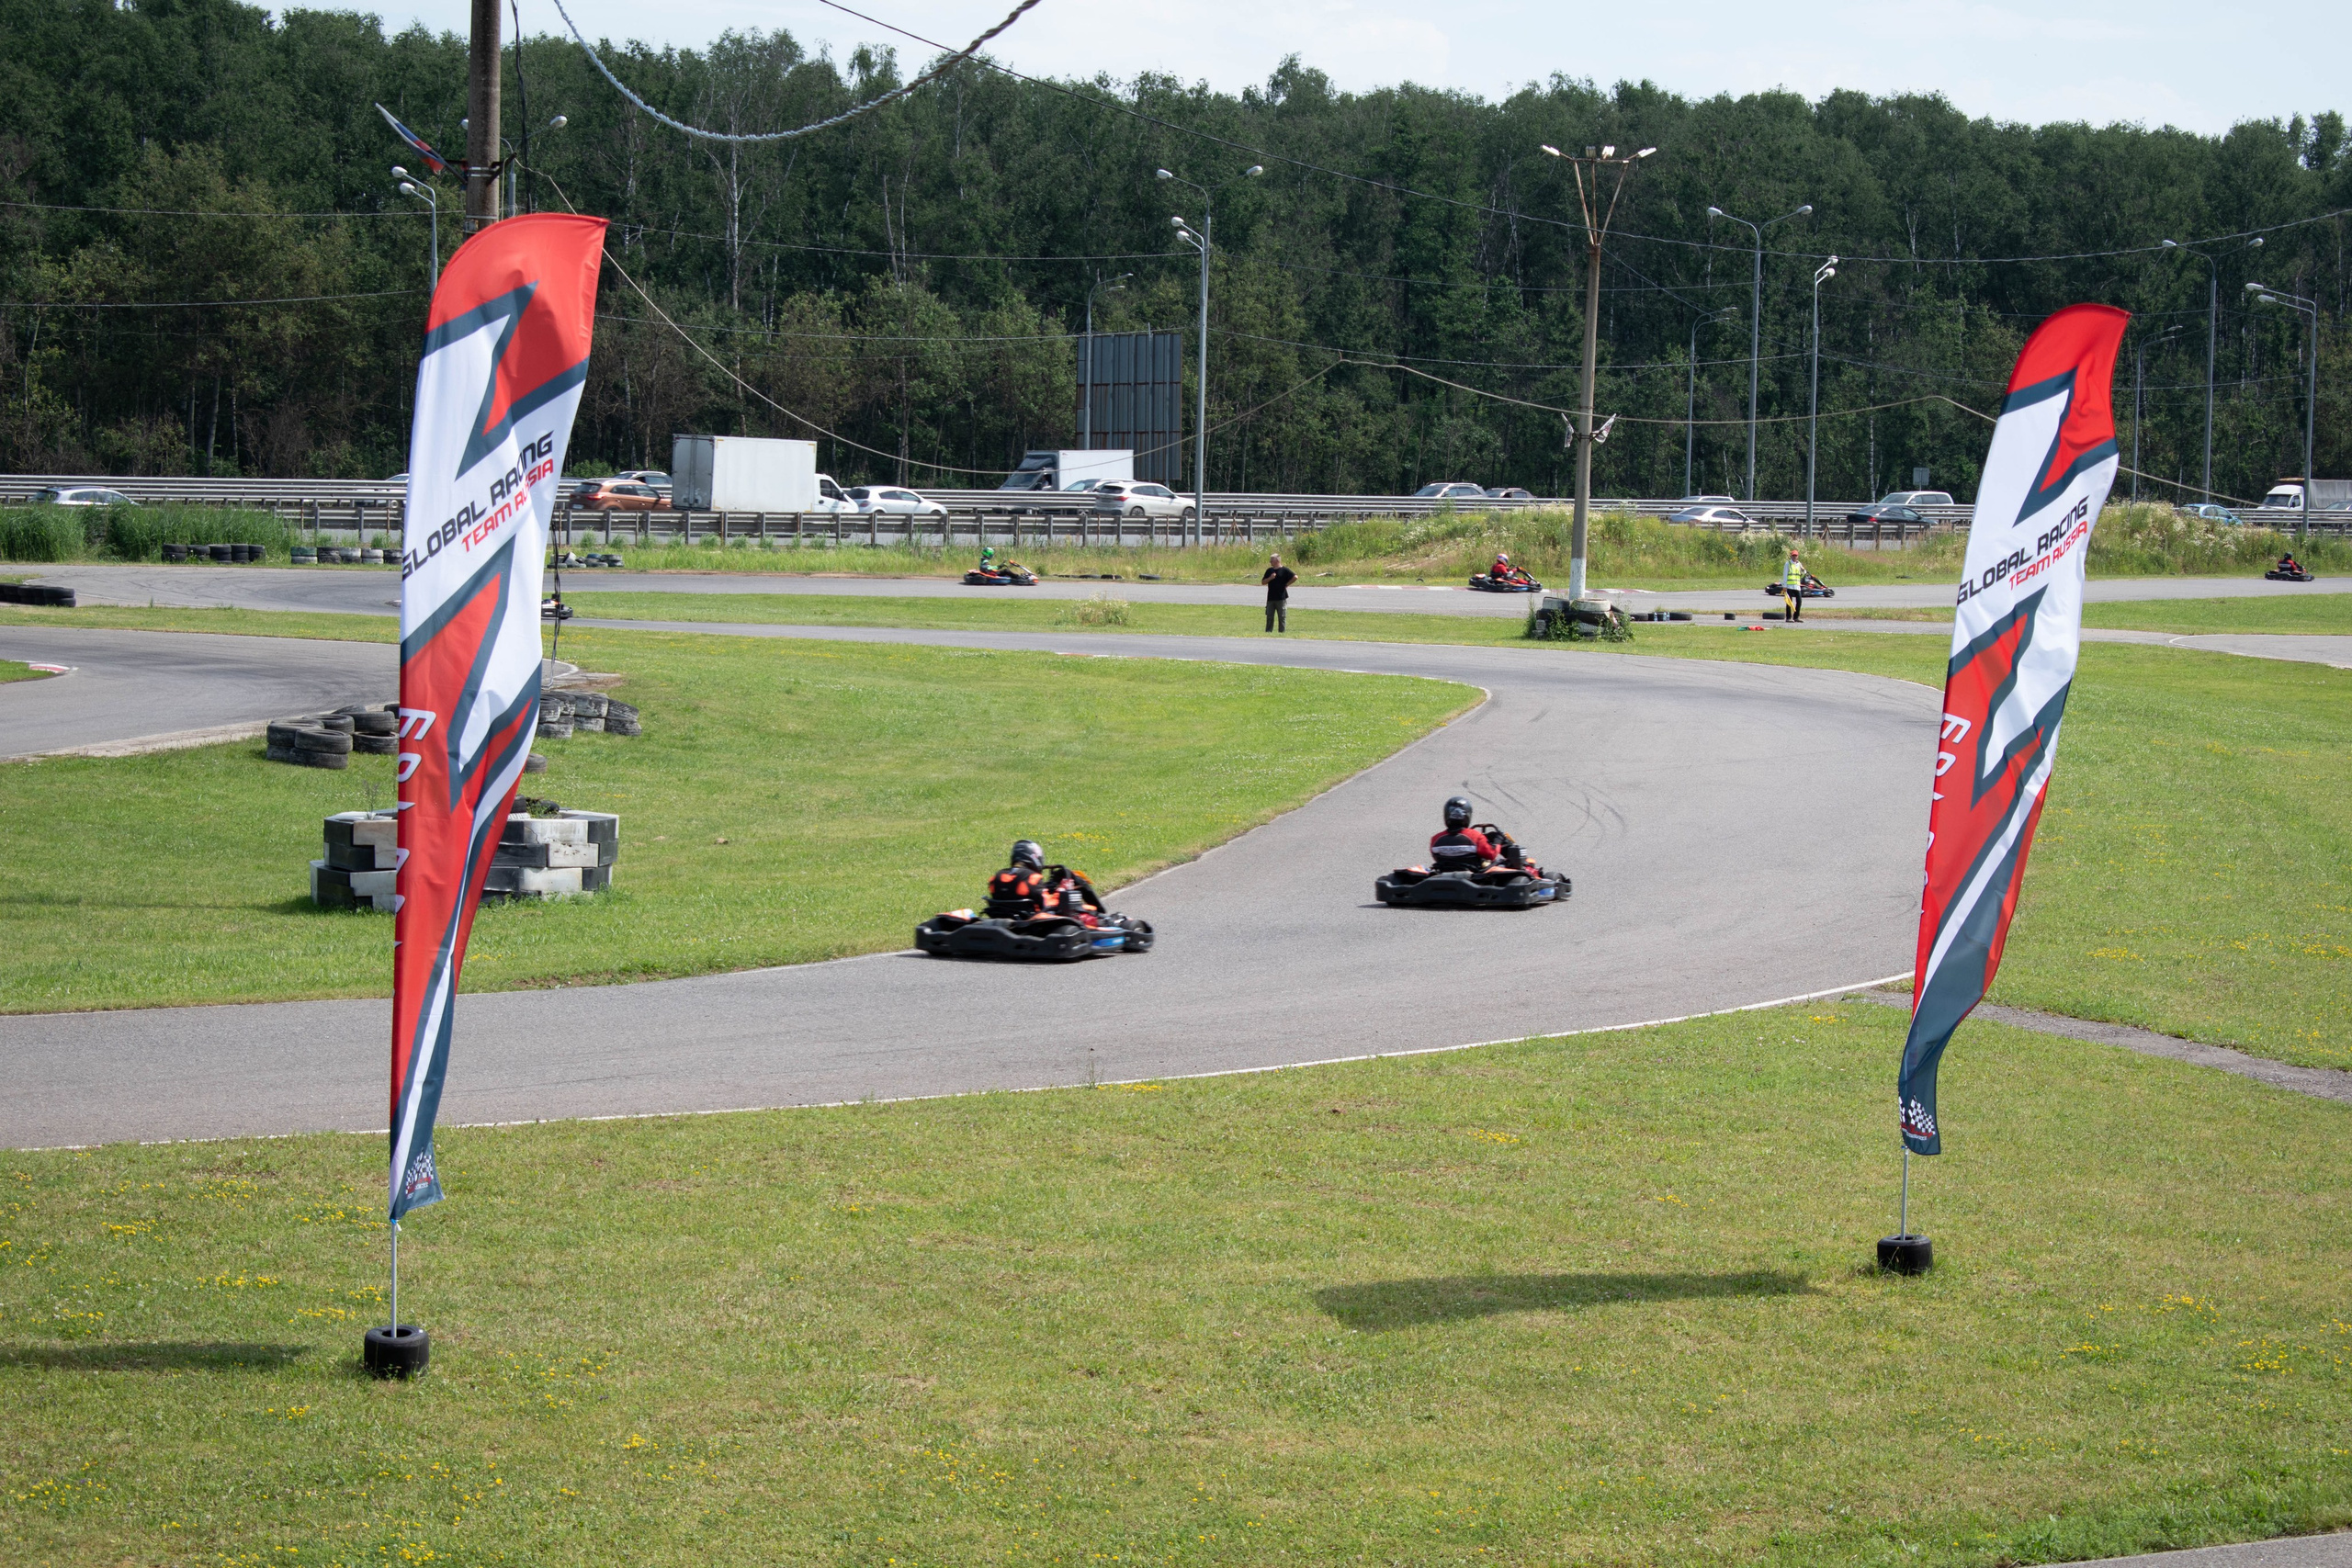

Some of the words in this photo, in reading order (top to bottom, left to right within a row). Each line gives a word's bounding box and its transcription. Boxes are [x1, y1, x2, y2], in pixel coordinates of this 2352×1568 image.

[402, 501, 488, 581] GLOBAL
[461, 502, 513, 553] TEAM
[1957, 547, 2033, 606] GLOBAL
[2037, 495, 2090, 557] RACING
[2009, 555, 2051, 591] TEAM
[2052, 521, 2087, 564] RUSSIA
